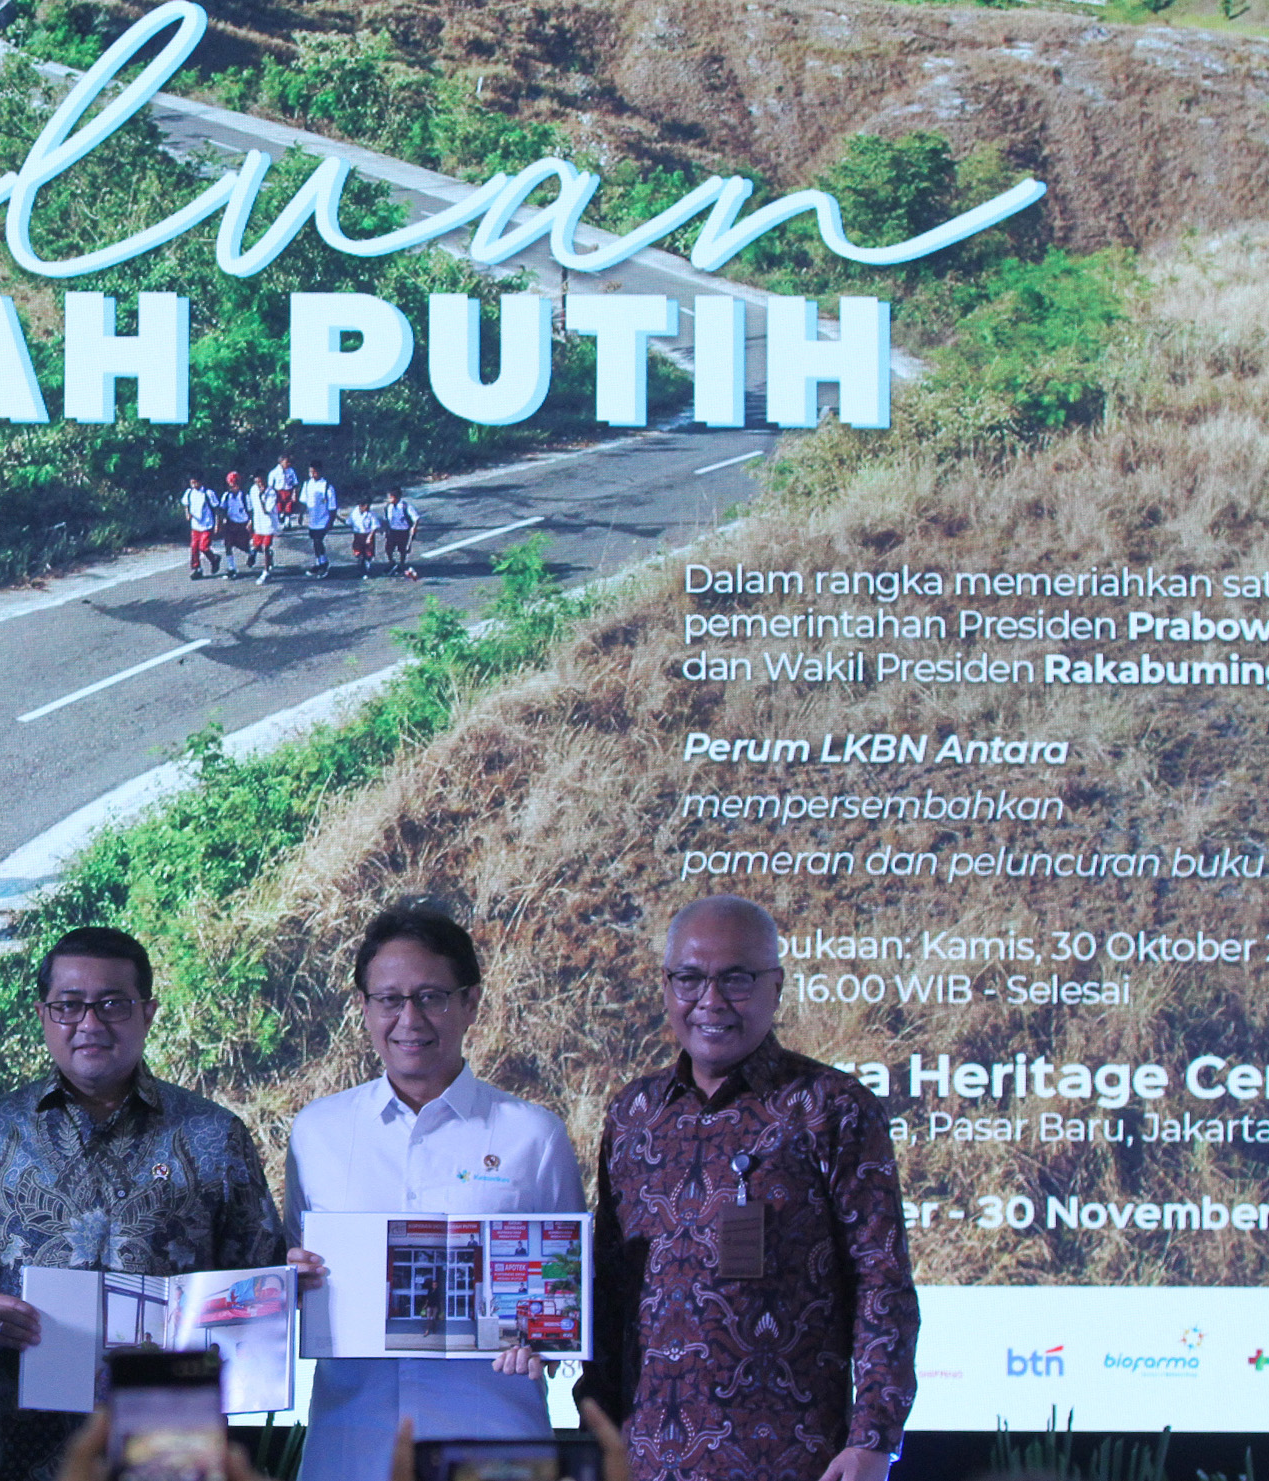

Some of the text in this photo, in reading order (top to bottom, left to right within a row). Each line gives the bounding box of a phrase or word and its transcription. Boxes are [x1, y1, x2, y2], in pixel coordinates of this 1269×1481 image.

[289, 292, 890, 428] PUTIH
[685, 564, 804, 594] Dalam
[815, 564, 943, 603] rangka
[955, 566, 1212, 597] memeriahkan
[685, 608, 1269, 645] pemerintahan Presiden Prabow
[682, 650, 1269, 691] dan Wakil Presiden Rakabumin
[684, 732, 1069, 764] Perum LKBN Antara
[681, 789, 1064, 825] mempersembahkan
[681, 844, 1264, 883] pameran dan peluncuran buku
[923, 929, 1042, 966] Kamis,
[1050, 931, 1097, 962] 30
[1106, 931, 1257, 962] Oktober
[793, 973, 886, 1004] 16.00
[894, 974, 973, 1004] WIB
[1007, 973, 1130, 1005] Selesai
[909, 1052, 1169, 1109] Heritage
[1185, 1054, 1269, 1100] Ce
[930, 1111, 1028, 1142] Pasar
[1039, 1112, 1133, 1148] Baru,
[1141, 1111, 1269, 1143] Jakarta
[948, 1210, 965, 1219] -
[977, 1195, 1034, 1230] 30
[1046, 1195, 1269, 1231] November
[1006, 1346, 1064, 1376] btn
[1104, 1353, 1199, 1374] biofarma
